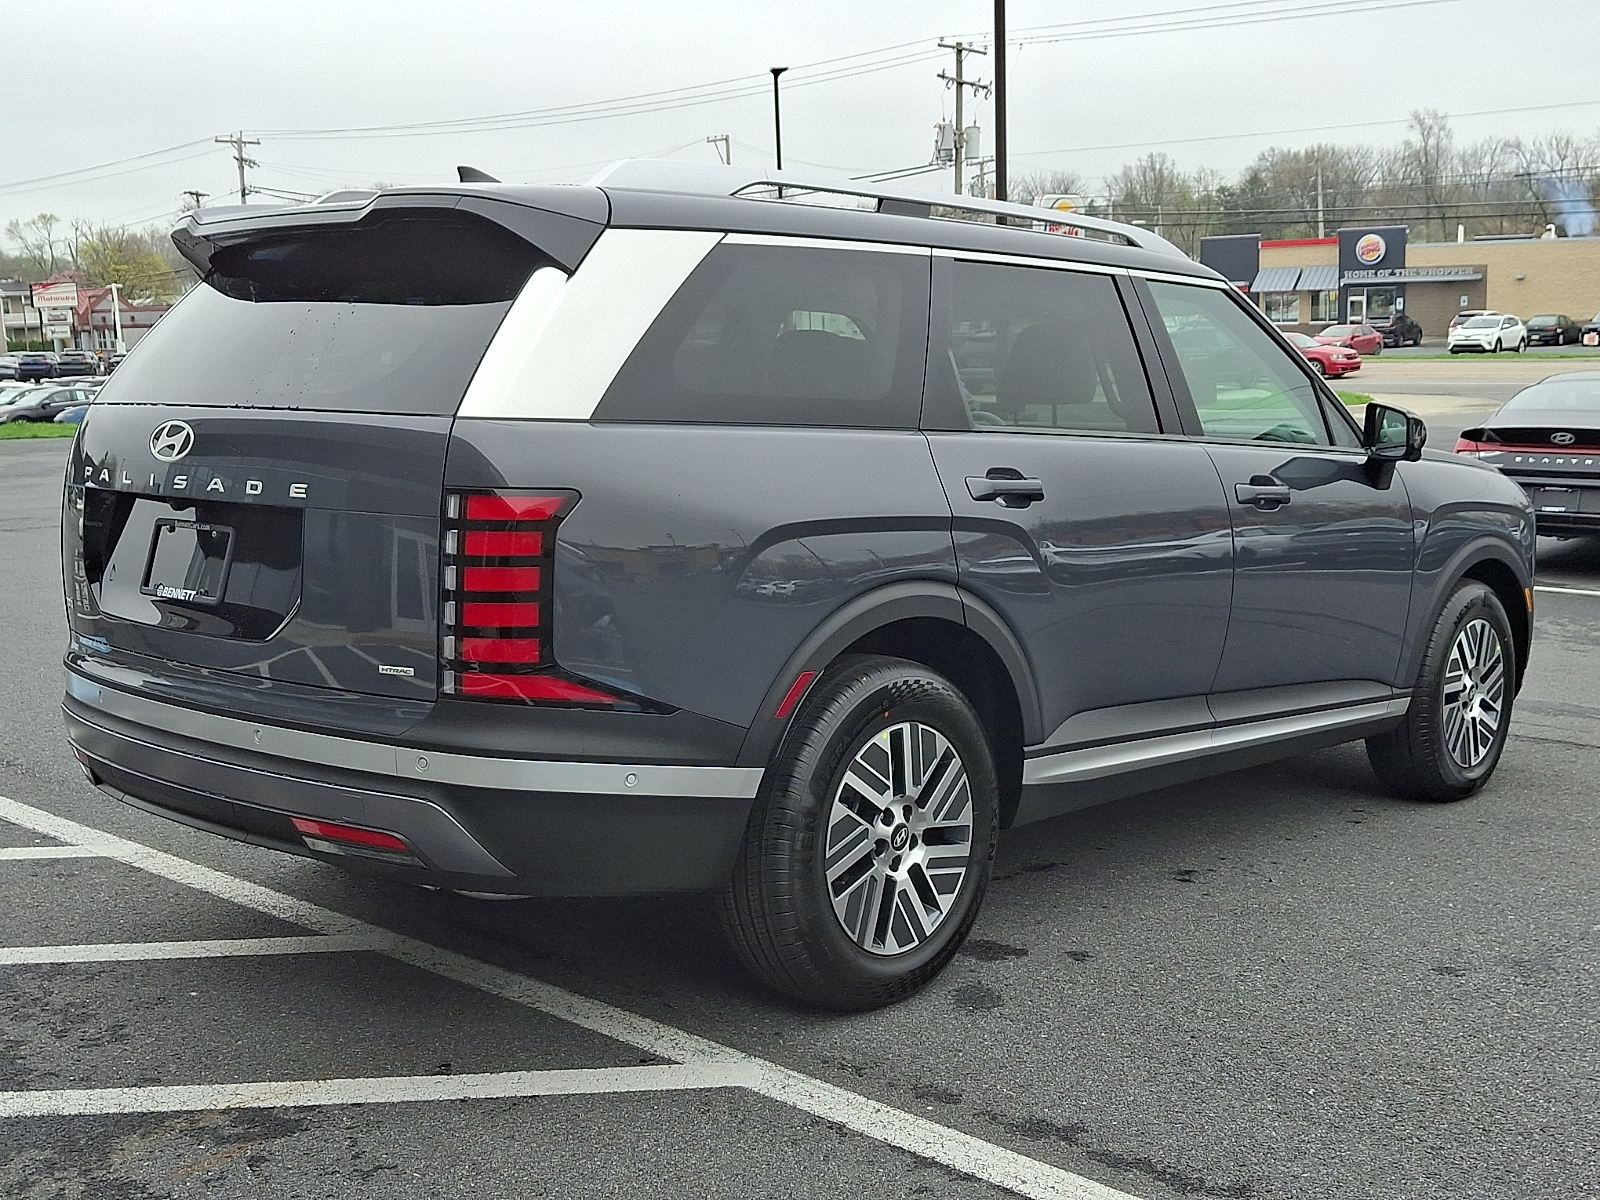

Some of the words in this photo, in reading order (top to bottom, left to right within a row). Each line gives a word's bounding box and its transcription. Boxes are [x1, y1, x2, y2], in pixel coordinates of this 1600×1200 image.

[1344, 270, 1375, 279] HOME
[1377, 269, 1392, 278] OF
[1394, 268, 1418, 277] THE
[1419, 266, 1474, 276] WHOPPER
[1515, 456, 1600, 466] ELANTR
[84, 466, 309, 499] PALISADE
[162, 586, 197, 602] BENNETT
